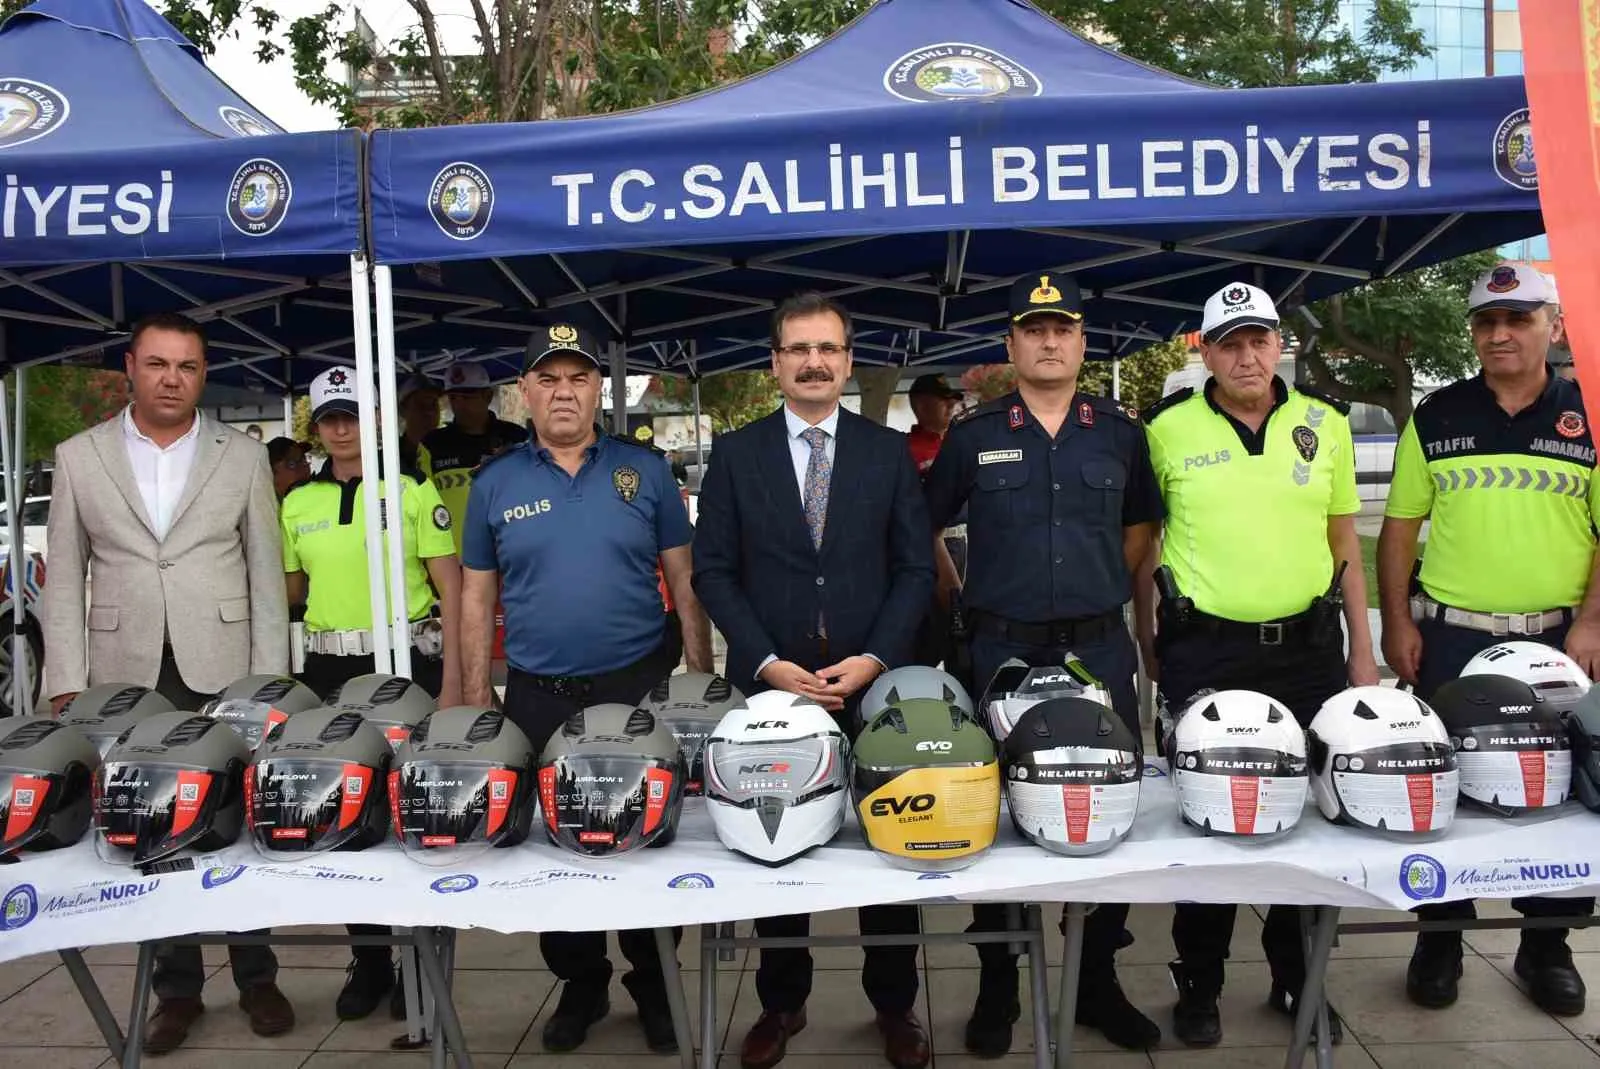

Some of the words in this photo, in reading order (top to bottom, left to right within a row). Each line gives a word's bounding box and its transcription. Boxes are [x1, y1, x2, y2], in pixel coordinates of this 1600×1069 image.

[551, 136, 965, 226] T.C.SALİHLİ
[991, 119, 1432, 203] BELEDİYESİ
[3, 170, 174, 239] İYESİ
[1500, 705, 1534, 713] SWAY
[744, 720, 790, 731] NCR
[1389, 720, 1422, 729] SWAY
[915, 741, 953, 752] EVO
[1489, 737, 1553, 745] HELMETS
[738, 763, 791, 775] NCR
[1206, 760, 1273, 769] HELMETS
[1377, 759, 1441, 768] HELMETS
[1038, 770, 1105, 778] HELMETS
[870, 793, 936, 817] EVO
[898, 814, 934, 824] ELEGANT
[1520, 863, 1591, 881] NURLU
[100, 879, 161, 903] NURLU
